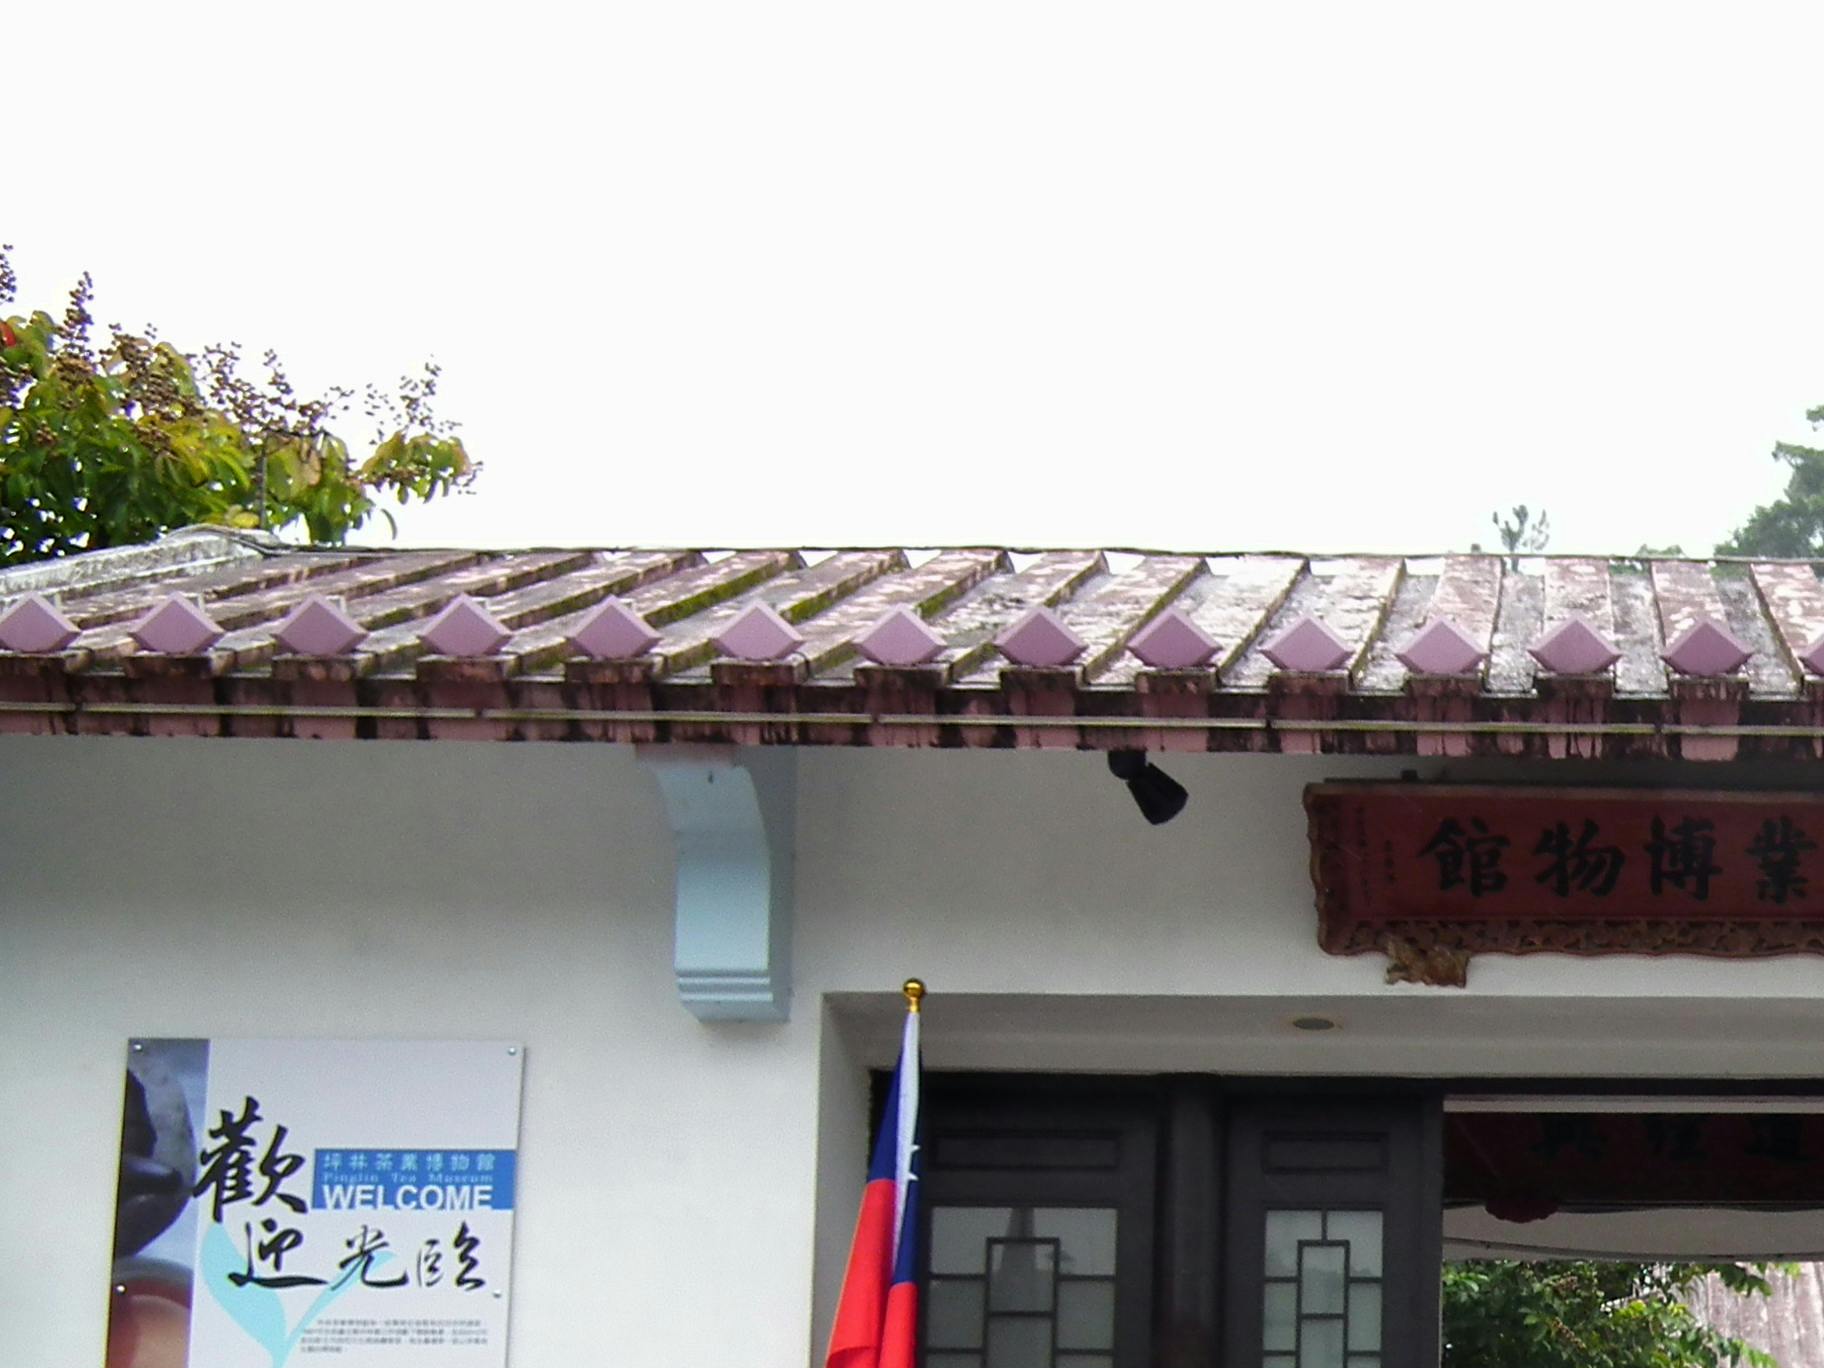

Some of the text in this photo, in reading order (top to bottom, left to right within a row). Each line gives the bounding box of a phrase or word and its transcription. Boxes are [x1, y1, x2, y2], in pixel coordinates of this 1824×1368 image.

[323, 1153, 496, 1172] 坪林茶業博物館
[322, 1184, 493, 1209] WELCOME
